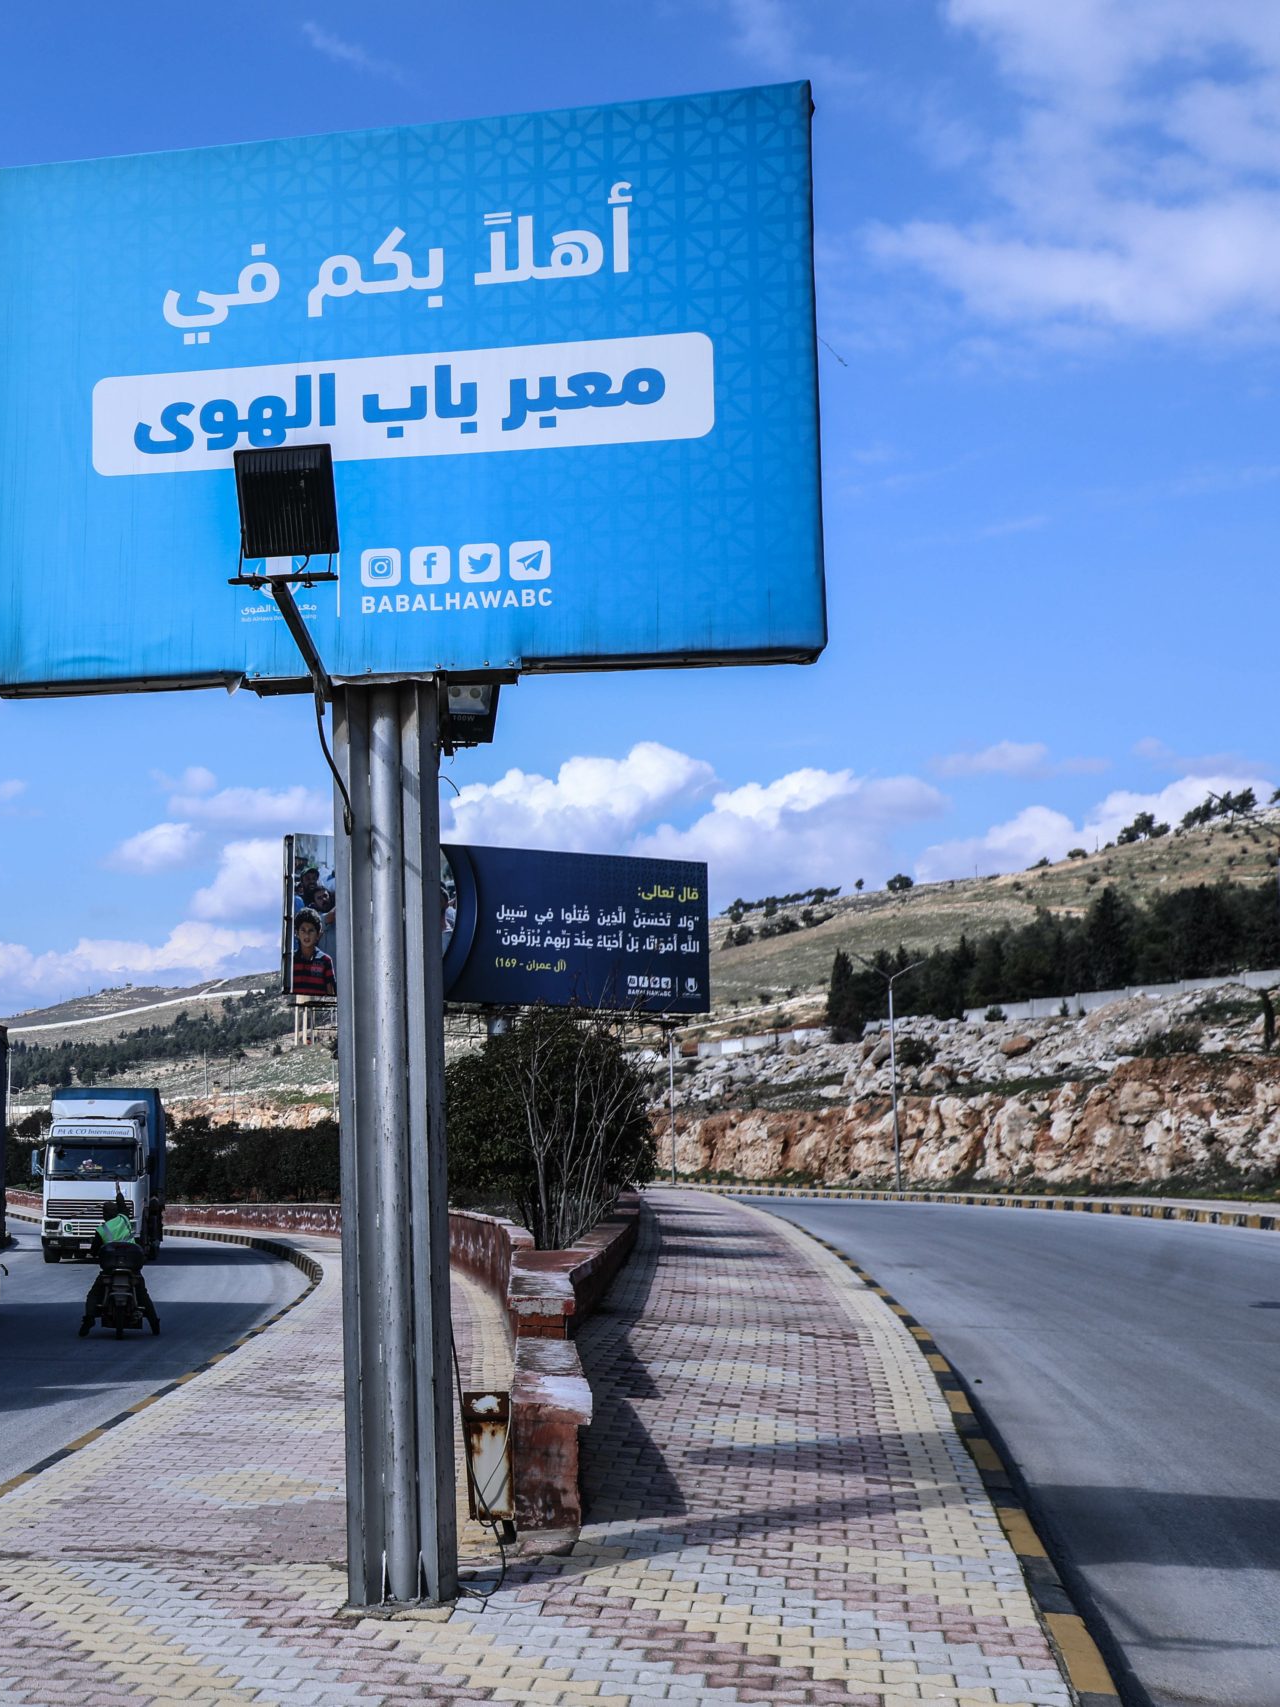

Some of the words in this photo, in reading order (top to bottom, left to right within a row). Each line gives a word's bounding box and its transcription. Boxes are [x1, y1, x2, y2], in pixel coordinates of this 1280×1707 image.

[473, 181, 633, 286] أهلاً
[162, 242, 280, 345] في
[307, 226, 444, 318] بكم
[133, 372, 335, 455] الهوى
[361, 364, 478, 438] باب
[501, 363, 666, 432] معبر
[240, 604, 271, 615] الهوى
[361, 588, 553, 614] BABALHAWABC
[637, 885, 675, 900] تعالى:
[678, 886, 699, 902] قال
[526, 959, 552, 971] عمران
